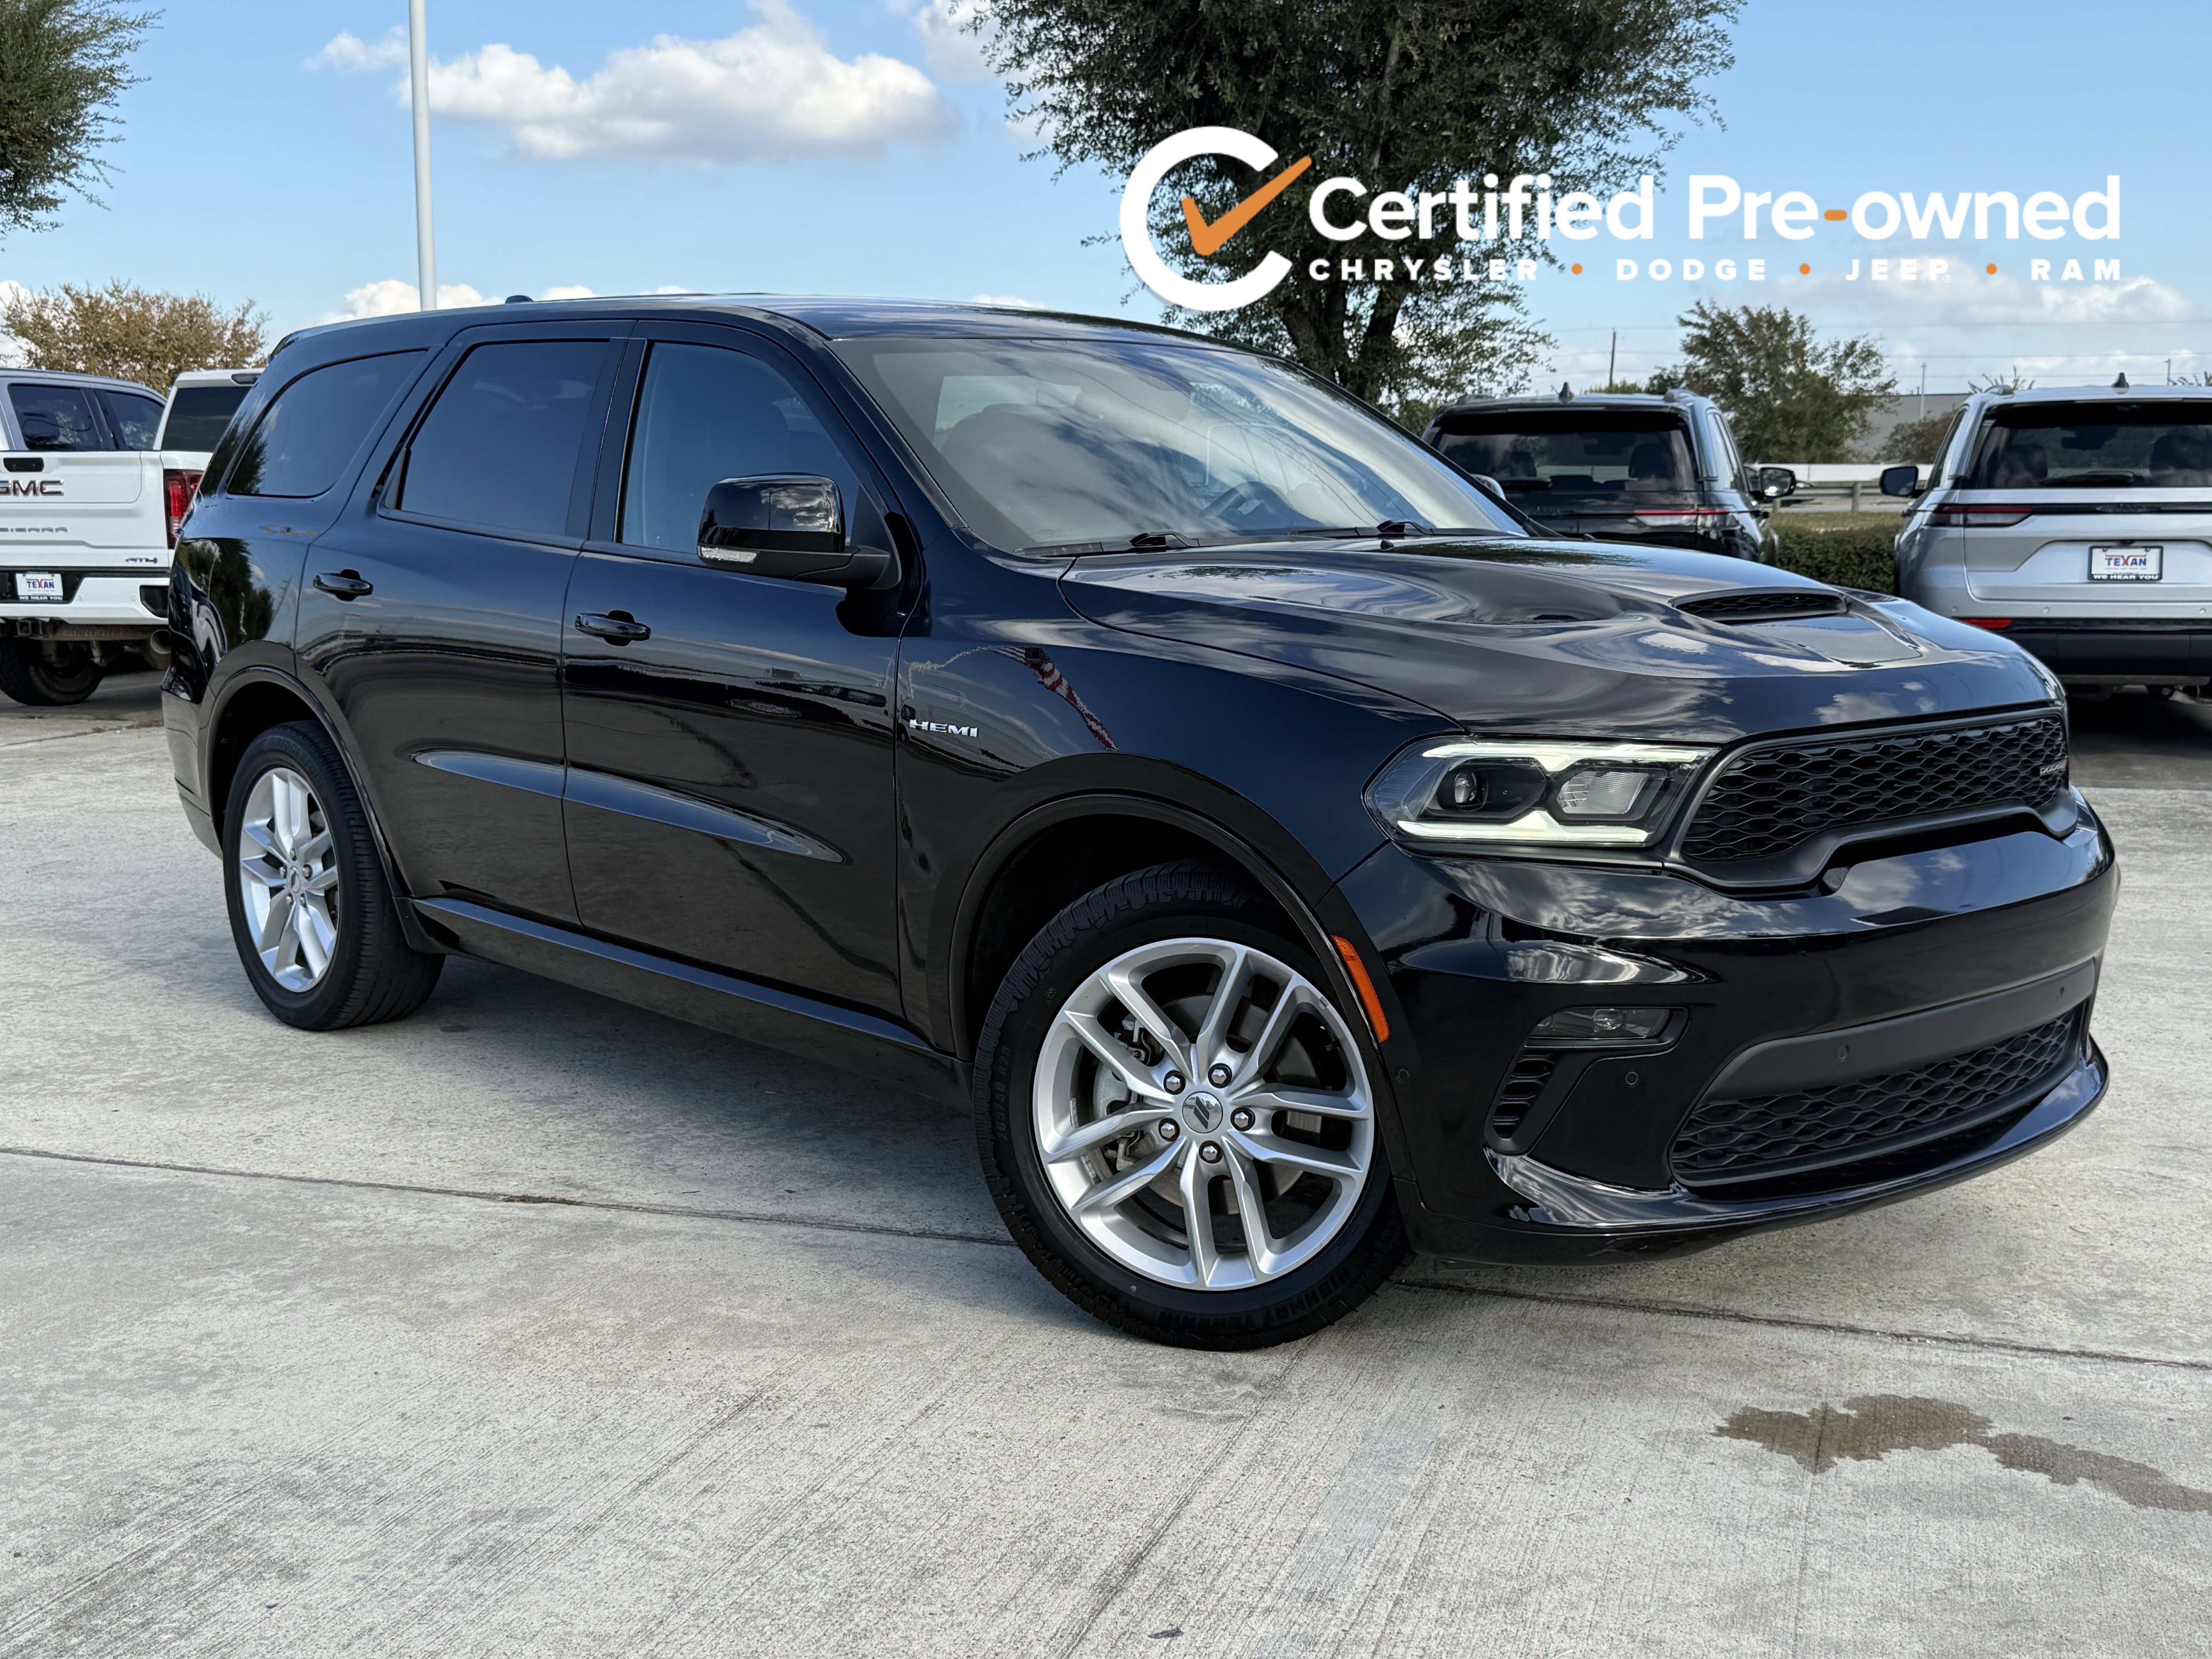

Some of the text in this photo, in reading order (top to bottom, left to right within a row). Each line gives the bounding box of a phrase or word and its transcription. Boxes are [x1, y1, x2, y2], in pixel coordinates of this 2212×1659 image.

[2104, 554, 2147, 567] TEXAN
[26, 578, 55, 589] TEXAN
[909, 719, 979, 737] HEMI
